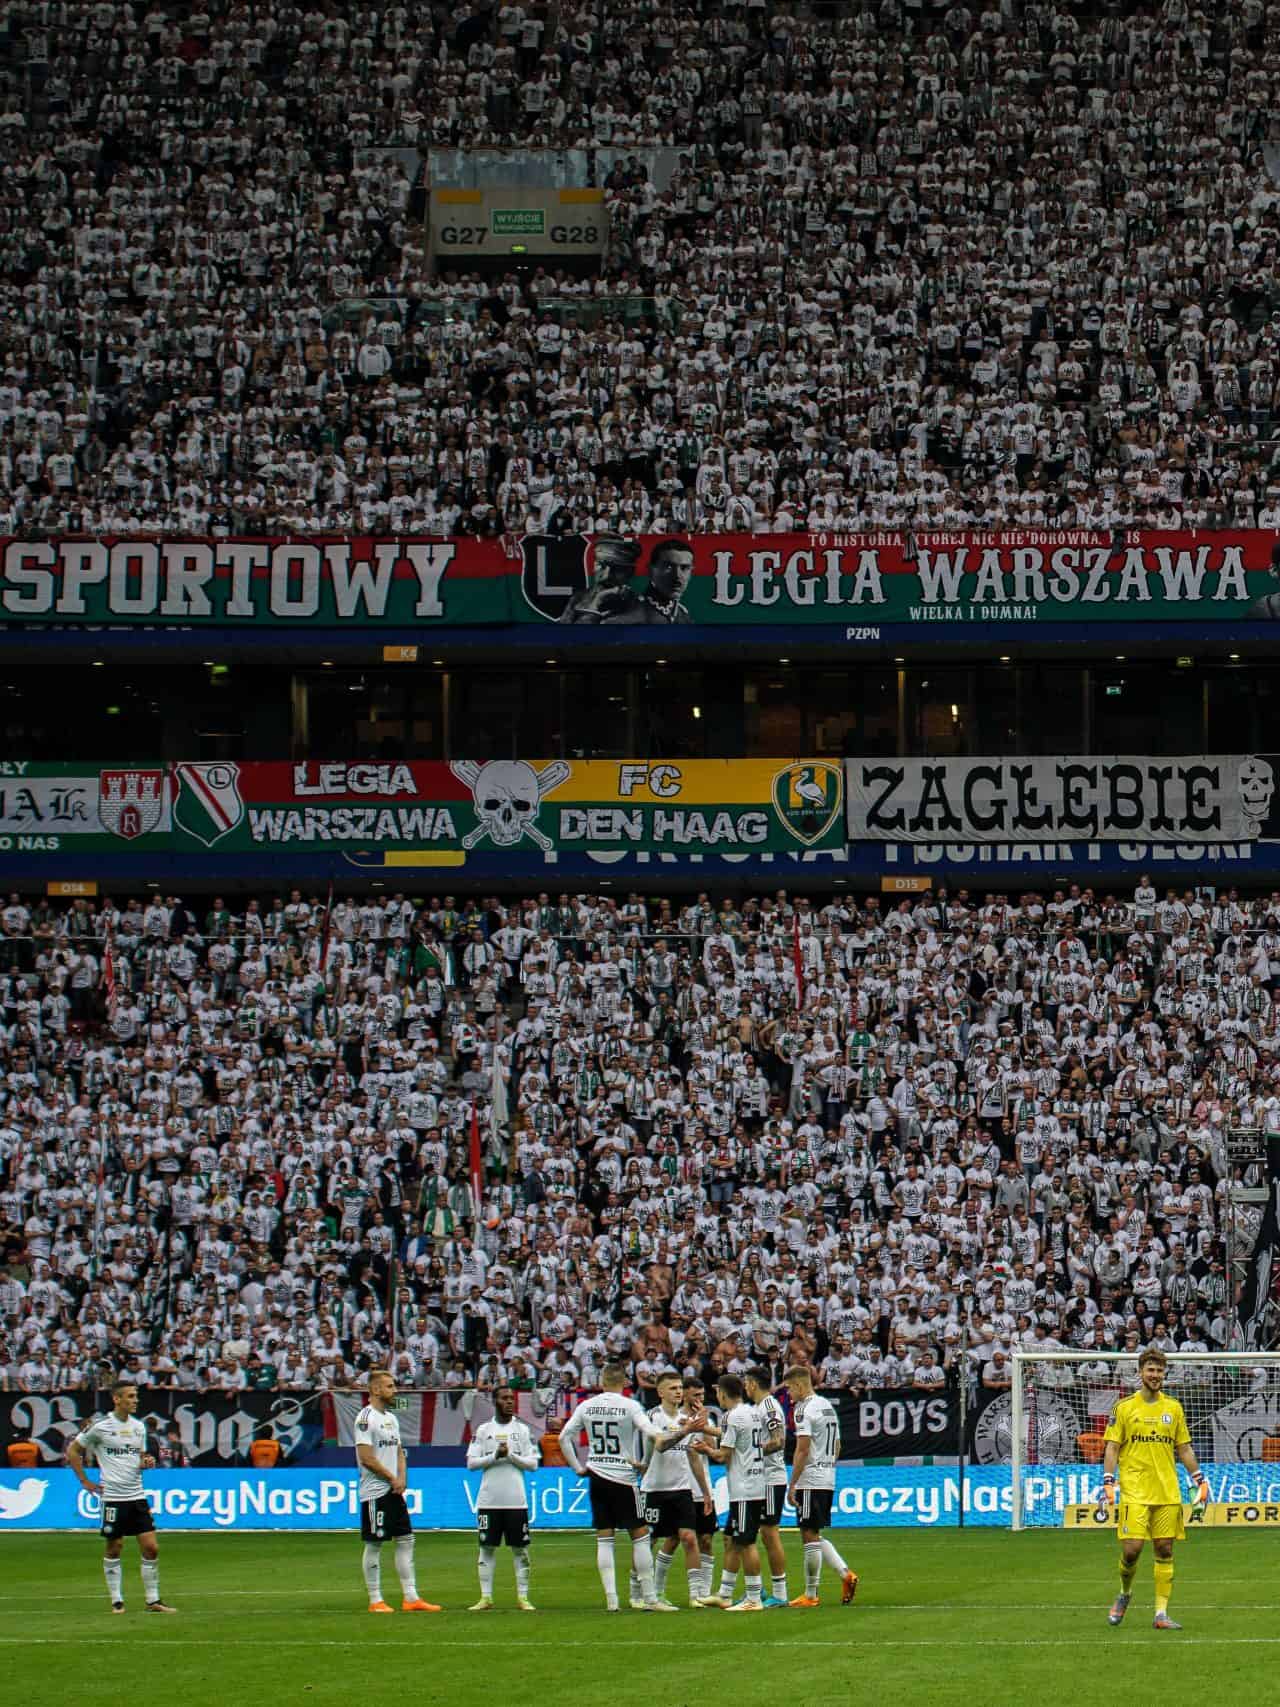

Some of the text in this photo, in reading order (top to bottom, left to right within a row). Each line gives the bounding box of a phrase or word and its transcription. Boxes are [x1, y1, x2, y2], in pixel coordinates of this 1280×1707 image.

[441, 227, 488, 245] G27
[550, 226, 599, 244] G28
[3, 541, 456, 618] SPORTOWY
[712, 545, 1252, 606] LEGIA WARSZAWA
[909, 606, 963, 621] WIELKA
[981, 605, 1037, 620] DUMNA!
[847, 627, 880, 641] PZPN
[294, 764, 418, 796] LEGIA
[619, 764, 682, 798] FC
[248, 807, 457, 842] WARSZAWA
[559, 809, 768, 844] DEN HAAG
[18, 836, 60, 851] NAS
[895, 879, 919, 890] D15
[858, 1398, 949, 1438] BOYS
[591, 1421, 620, 1455] 55
[826, 1421, 837, 1457] 17
[376, 1510, 385, 1527] 8
